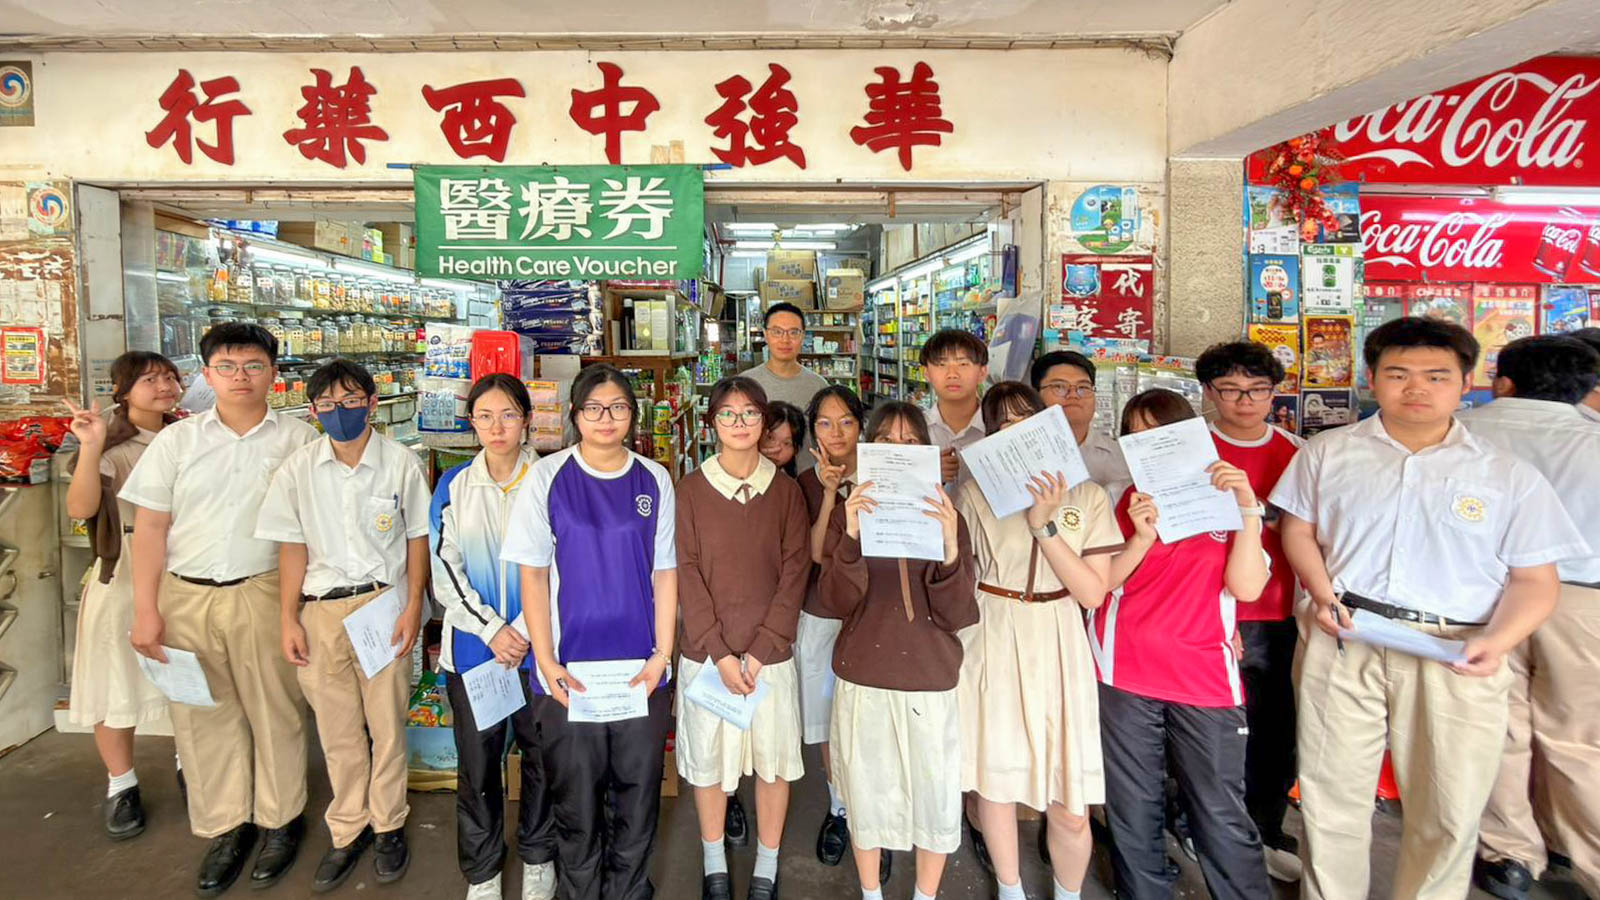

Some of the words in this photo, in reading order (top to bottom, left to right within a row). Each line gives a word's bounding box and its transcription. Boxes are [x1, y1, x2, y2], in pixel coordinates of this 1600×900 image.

[1334, 72, 1600, 168] oca-Cola
[440, 176, 674, 241] 醫療券
[1360, 210, 1512, 268] Coca-Cola
[438, 256, 512, 275] Health
[516, 257, 571, 275] Care
[572, 256, 678, 275] Voucher
